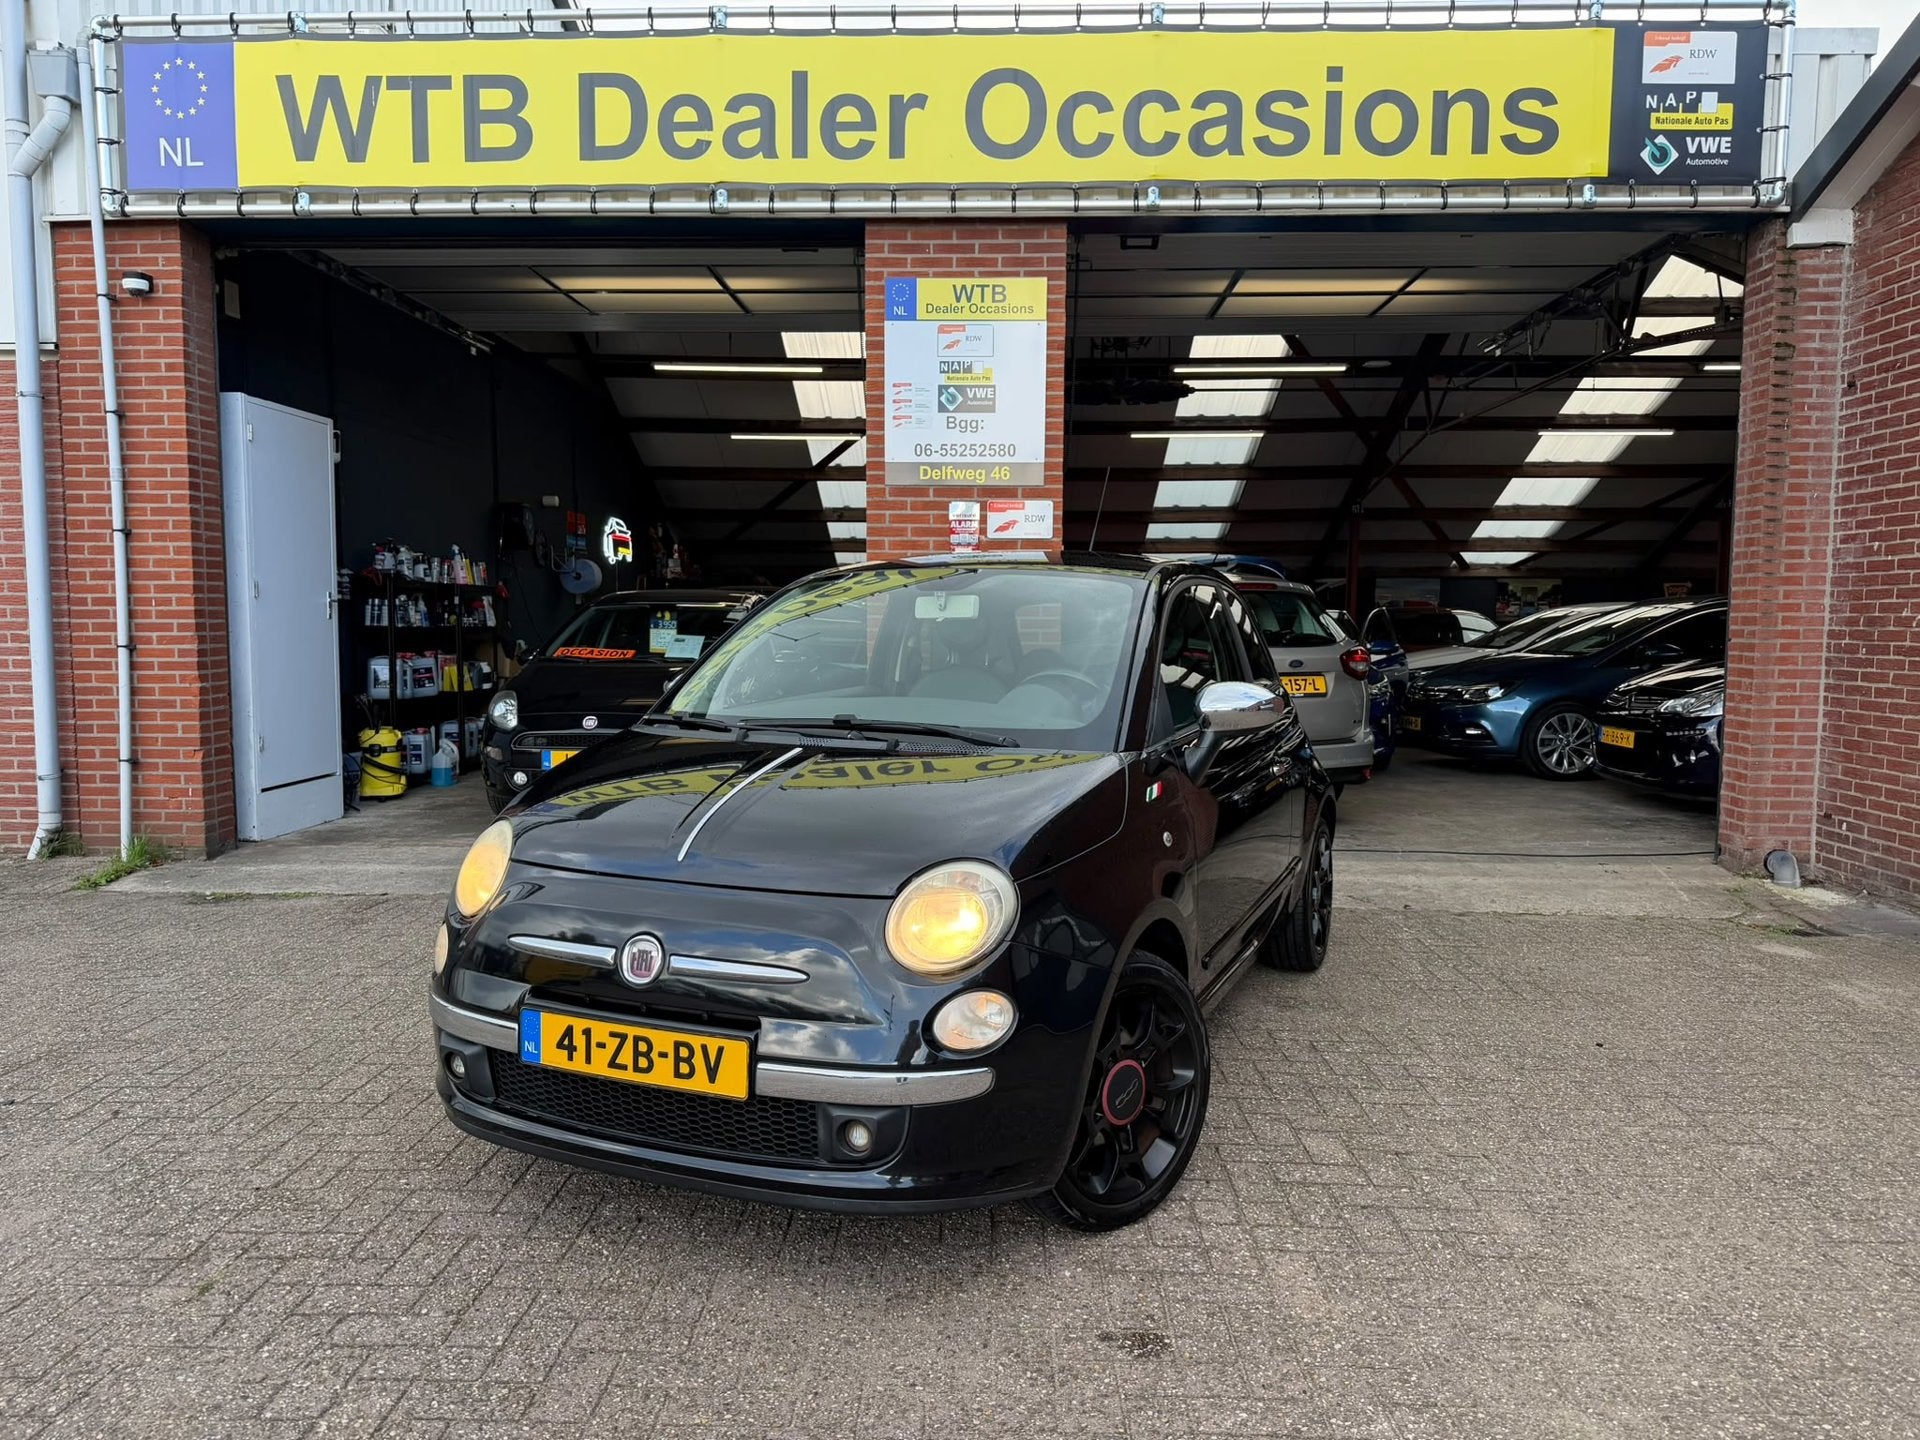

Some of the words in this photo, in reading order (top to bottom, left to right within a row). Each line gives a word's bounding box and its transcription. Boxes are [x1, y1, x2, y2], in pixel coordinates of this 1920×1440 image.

[1689, 49, 1717, 59] RDW
[275, 73, 535, 163] WTB
[577, 70, 927, 162] Dealer
[964, 66, 1560, 160] Occasions
[1655, 116, 1692, 126] Nationale
[1694, 117, 1713, 126] Auto
[1714, 117, 1729, 126] Pas
[158, 136, 205, 167] NL
[1685, 136, 1732, 154] VWE
[1686, 157, 1729, 166] Automotive
[952, 284, 1007, 303] WTB
[893, 306, 908, 316] NL
[925, 303, 966, 314] Dealer
[968, 303, 1034, 314] Occasions
[966, 387, 995, 398] VWE
[946, 416, 984, 433] Bgg:
[914, 443, 1017, 457] 06-55252580
[919, 465, 986, 483] Delfweg
[990, 465, 1011, 480] 46
[950, 520, 979, 529] ALARM
[1024, 514, 1046, 523] RDW
[560, 648, 629, 658] OCCASION
[1280, 678, 1320, 692] -157-L
[524, 1040, 538, 1054] NL
[555, 1024, 726, 1085] 41-ZB-BV
